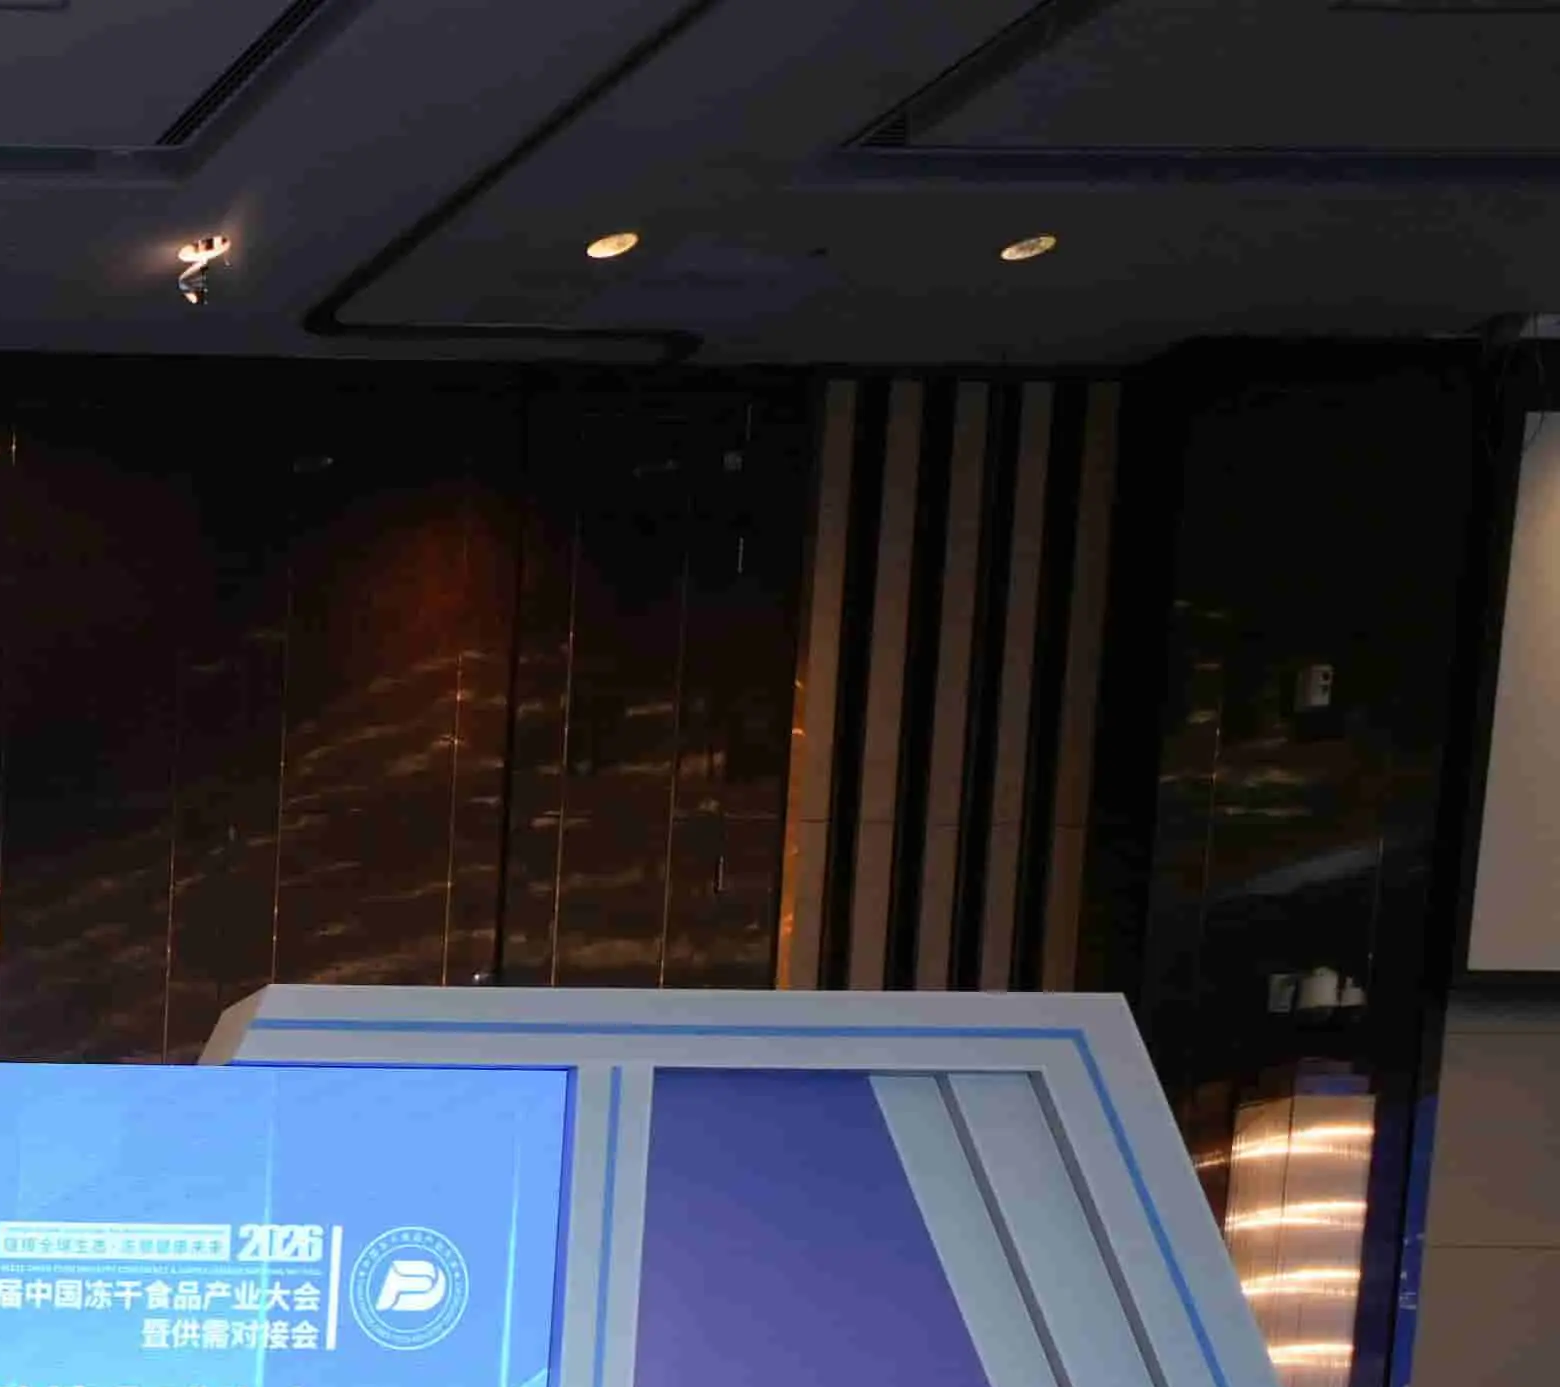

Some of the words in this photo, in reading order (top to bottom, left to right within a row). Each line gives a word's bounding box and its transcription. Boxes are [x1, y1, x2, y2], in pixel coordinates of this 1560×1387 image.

[237, 1223, 324, 1262] 2026
[140, 1318, 320, 1351] 暨供需对接会
